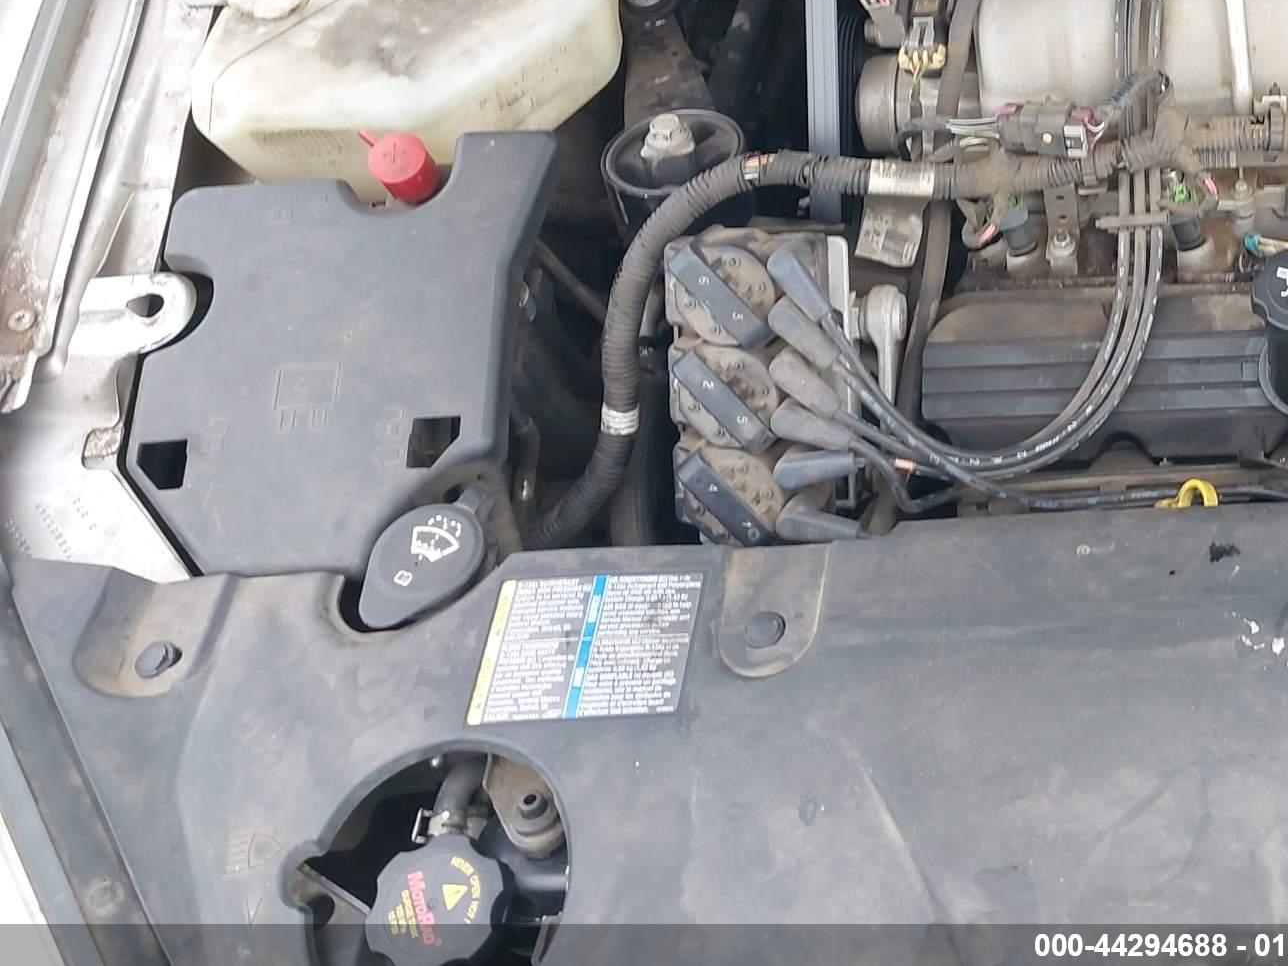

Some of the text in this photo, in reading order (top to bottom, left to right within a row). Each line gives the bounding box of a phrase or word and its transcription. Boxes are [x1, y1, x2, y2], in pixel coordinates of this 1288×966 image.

[732, 311, 744, 320] 3
[702, 380, 714, 390] 2
[736, 416, 748, 425] 5
[709, 484, 718, 492] 4
